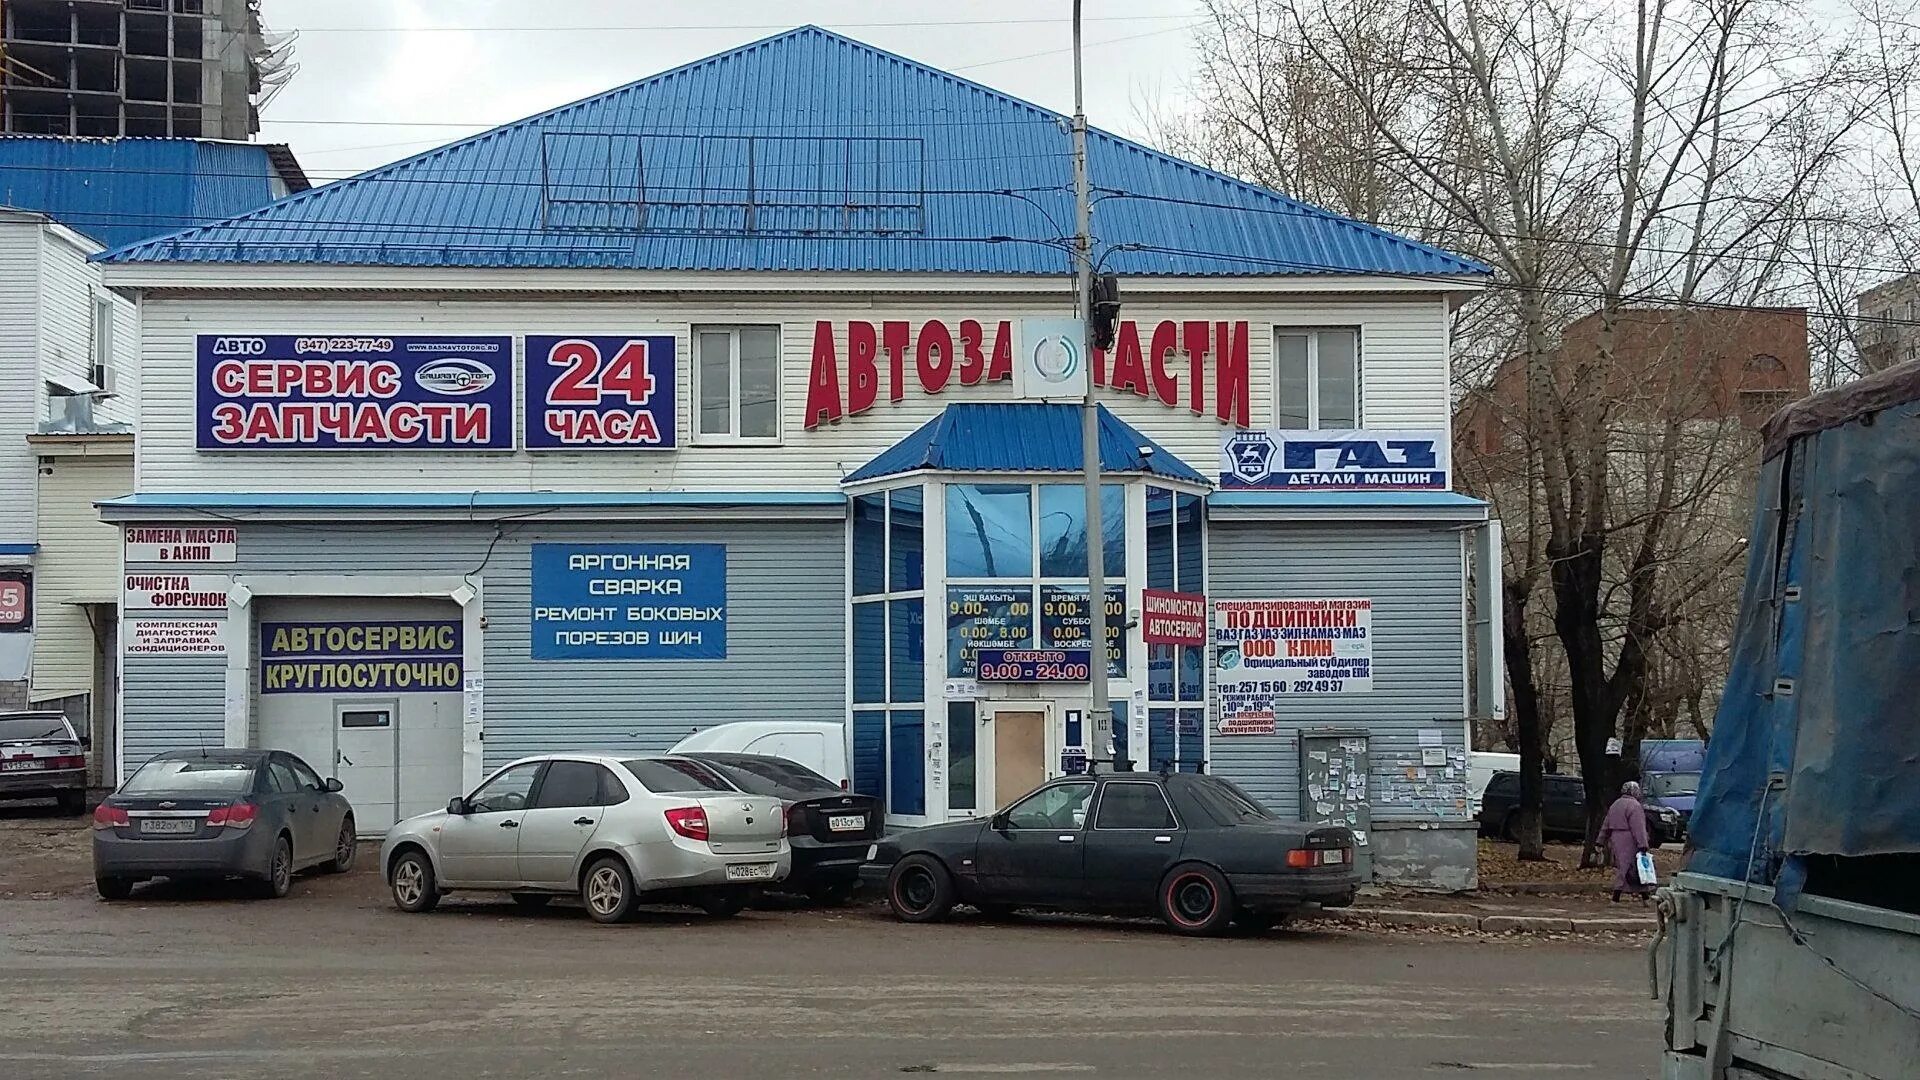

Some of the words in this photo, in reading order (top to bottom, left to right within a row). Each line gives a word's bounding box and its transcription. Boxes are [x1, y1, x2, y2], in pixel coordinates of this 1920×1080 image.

[214, 339, 265, 353] АВТО
[296, 338, 328, 353] (347)
[331, 339, 393, 352] 223-77-49
[214, 362, 400, 395] СЕРВИС
[549, 340, 653, 403] 24
[804, 319, 1250, 429] АВТОЗААСТИ
[214, 405, 490, 442] ЗАПЧАСТИ
[547, 411, 660, 441] ЧАСА
[1284, 441, 1436, 469] ГАЗ
[1288, 473, 1355, 485] ДЕТАЛИ
[1365, 473, 1431, 484] МАШИН
[127, 529, 182, 543] ЗАМЕНА
[186, 529, 235, 543] МАСЛА
[173, 546, 211, 560] АКПП
[569, 554, 690, 570] АРГОННАЯ
[127, 576, 190, 590] ОЧИСТКА
[589, 579, 682, 595] СВАРКА
[0, 588, 18, 606] 5
[151, 592, 227, 606] ФОРСУНОК
[1146, 596, 1204, 617] ШИНОМОНТАЖ
[1216, 600, 1327, 611] специализированный
[1329, 601, 1370, 610] магазин
[535, 607, 618, 621] РЕМОНТ
[627, 607, 723, 621] БОКОВЫХ
[1227, 610, 1356, 628] ПОДШИПНИКИ
[1149, 619, 1202, 638] АВТОСЕРВИС
[272, 626, 454, 651] АВТОСЕРВИС
[556, 631, 650, 645] ПОРЕЗОВ
[659, 631, 702, 645] ШИН
[1243, 640, 1275, 657] ООО
[1004, 652, 1065, 662] ОТКРЫТО
[1244, 657, 1318, 669] Официальный
[1320, 657, 1369, 668] субдилер
[266, 663, 459, 688] КРУГЛОСУТОЧНО
[982, 664, 1021, 679] 9.00
[1036, 664, 1087, 679] 24.00
[1308, 669, 1350, 679] заводов
[1352, 668, 1370, 678] ЕПК
[1294, 681, 1313, 692] 292
